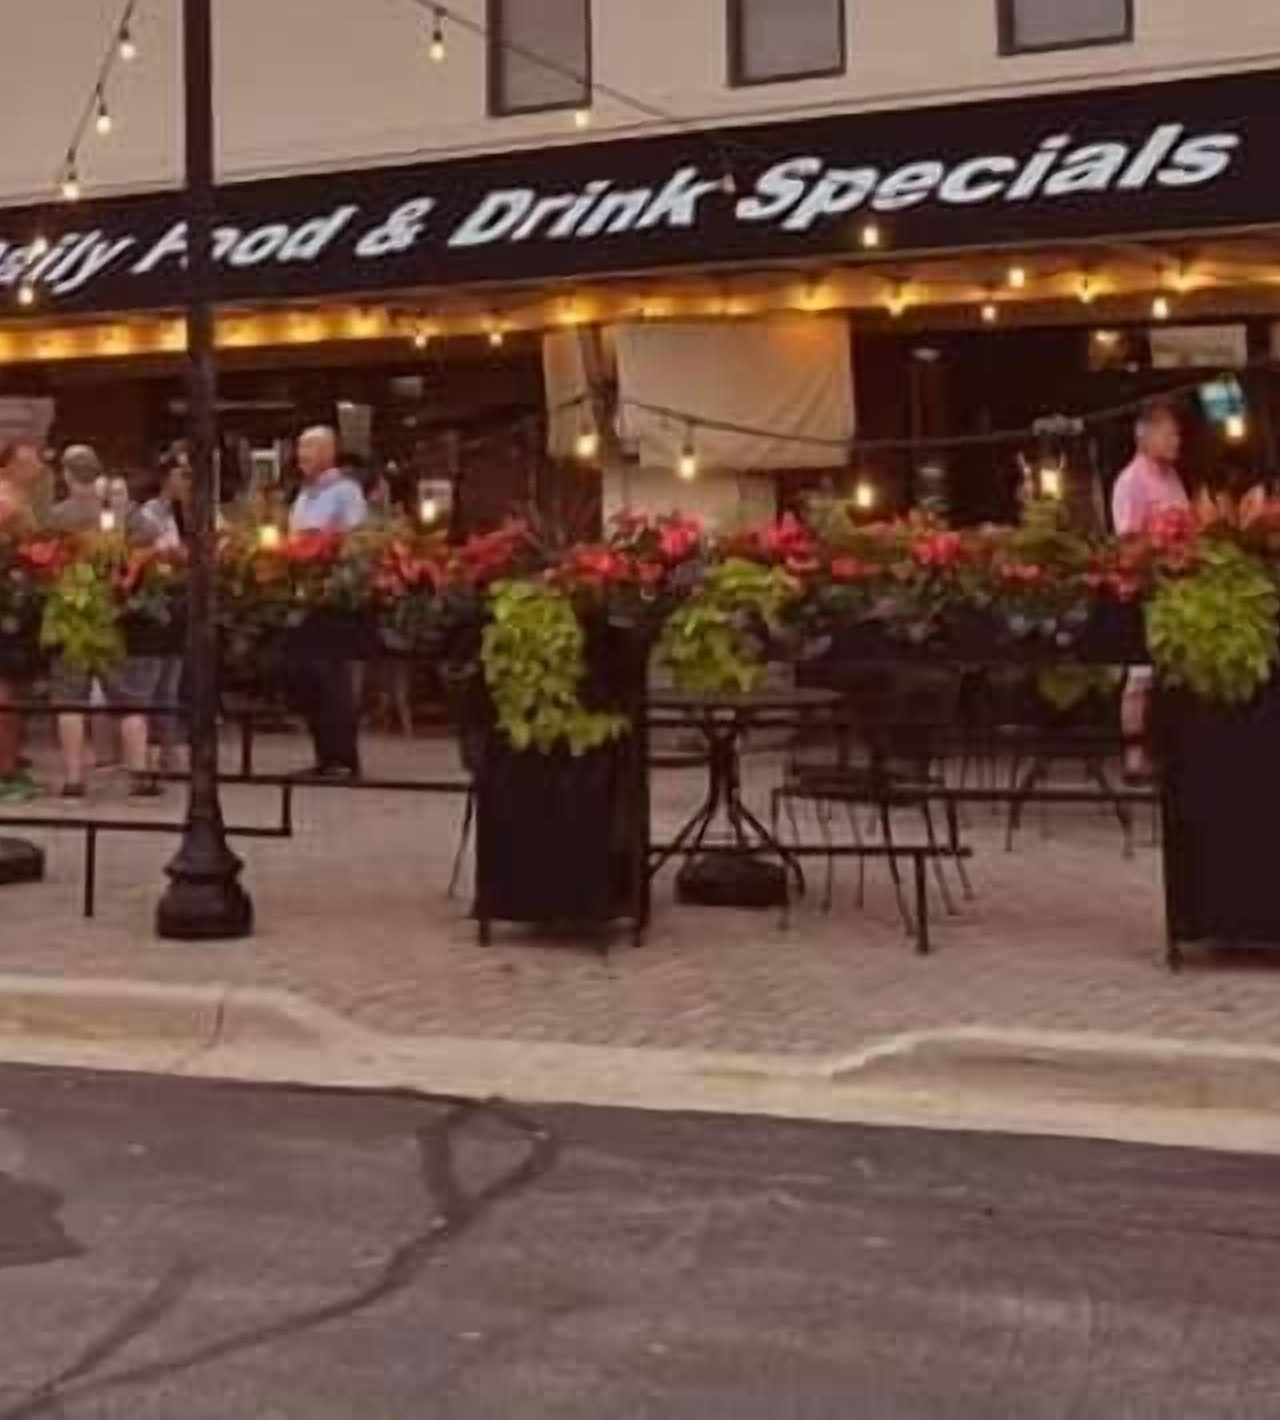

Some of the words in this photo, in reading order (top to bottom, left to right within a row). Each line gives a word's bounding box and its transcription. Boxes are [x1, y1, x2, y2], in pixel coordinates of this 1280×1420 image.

[355, 197, 436, 256] &
[447, 168, 720, 247] Drink
[736, 125, 1242, 229] Specials
